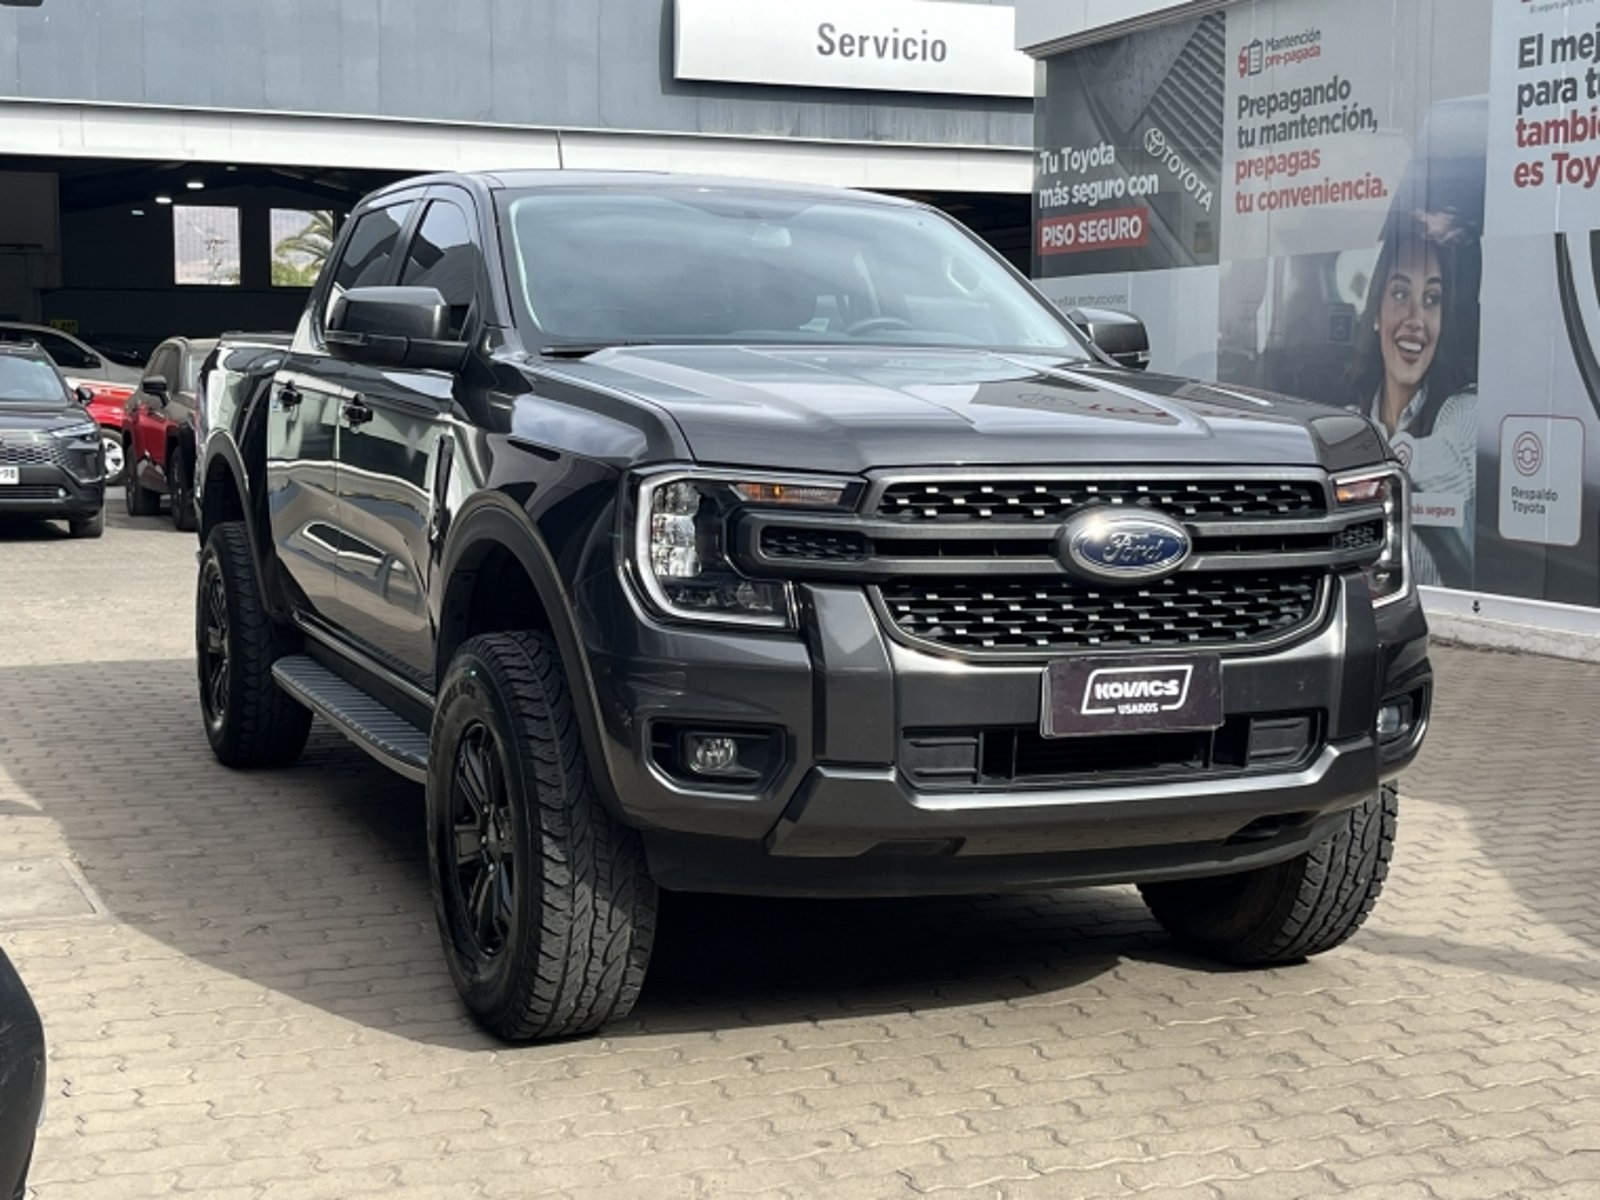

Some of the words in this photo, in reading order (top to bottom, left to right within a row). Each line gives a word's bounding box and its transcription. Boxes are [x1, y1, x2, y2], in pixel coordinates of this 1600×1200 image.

[816, 22, 947, 62] Servicio
[1265, 29, 1321, 52] Mantención
[1265, 44, 1321, 69] pre-pagada
[1518, 33, 1544, 69] El
[1237, 75, 1351, 120] Prepagando
[1517, 77, 1577, 116] para
[1238, 126, 1256, 149] tu
[1259, 102, 1378, 146] mantención,
[1516, 106, 1600, 148] tambi
[1039, 150, 1059, 176] Tu
[1061, 141, 1115, 174] Toyota
[1235, 148, 1321, 185] prepagas
[1514, 161, 1544, 188] es
[1039, 181, 1070, 209] más
[1071, 177, 1126, 207] seguro
[1127, 173, 1160, 197] con
[1161, 144, 1213, 212] TOYOTA
[1235, 191, 1254, 214] tu
[1257, 172, 1388, 212] conveniencia.
[1041, 223, 1076, 248] PISO
[1078, 215, 1142, 244] SEGURO
[1425, 505, 1456, 518] seguro
[1510, 486, 1558, 502] Respaldo
[1512, 501, 1546, 515] Toyota
[1102, 532, 1164, 562] Ford
[1094, 679, 1180, 699] KOVACS
[1117, 702, 1159, 714] USADOS
